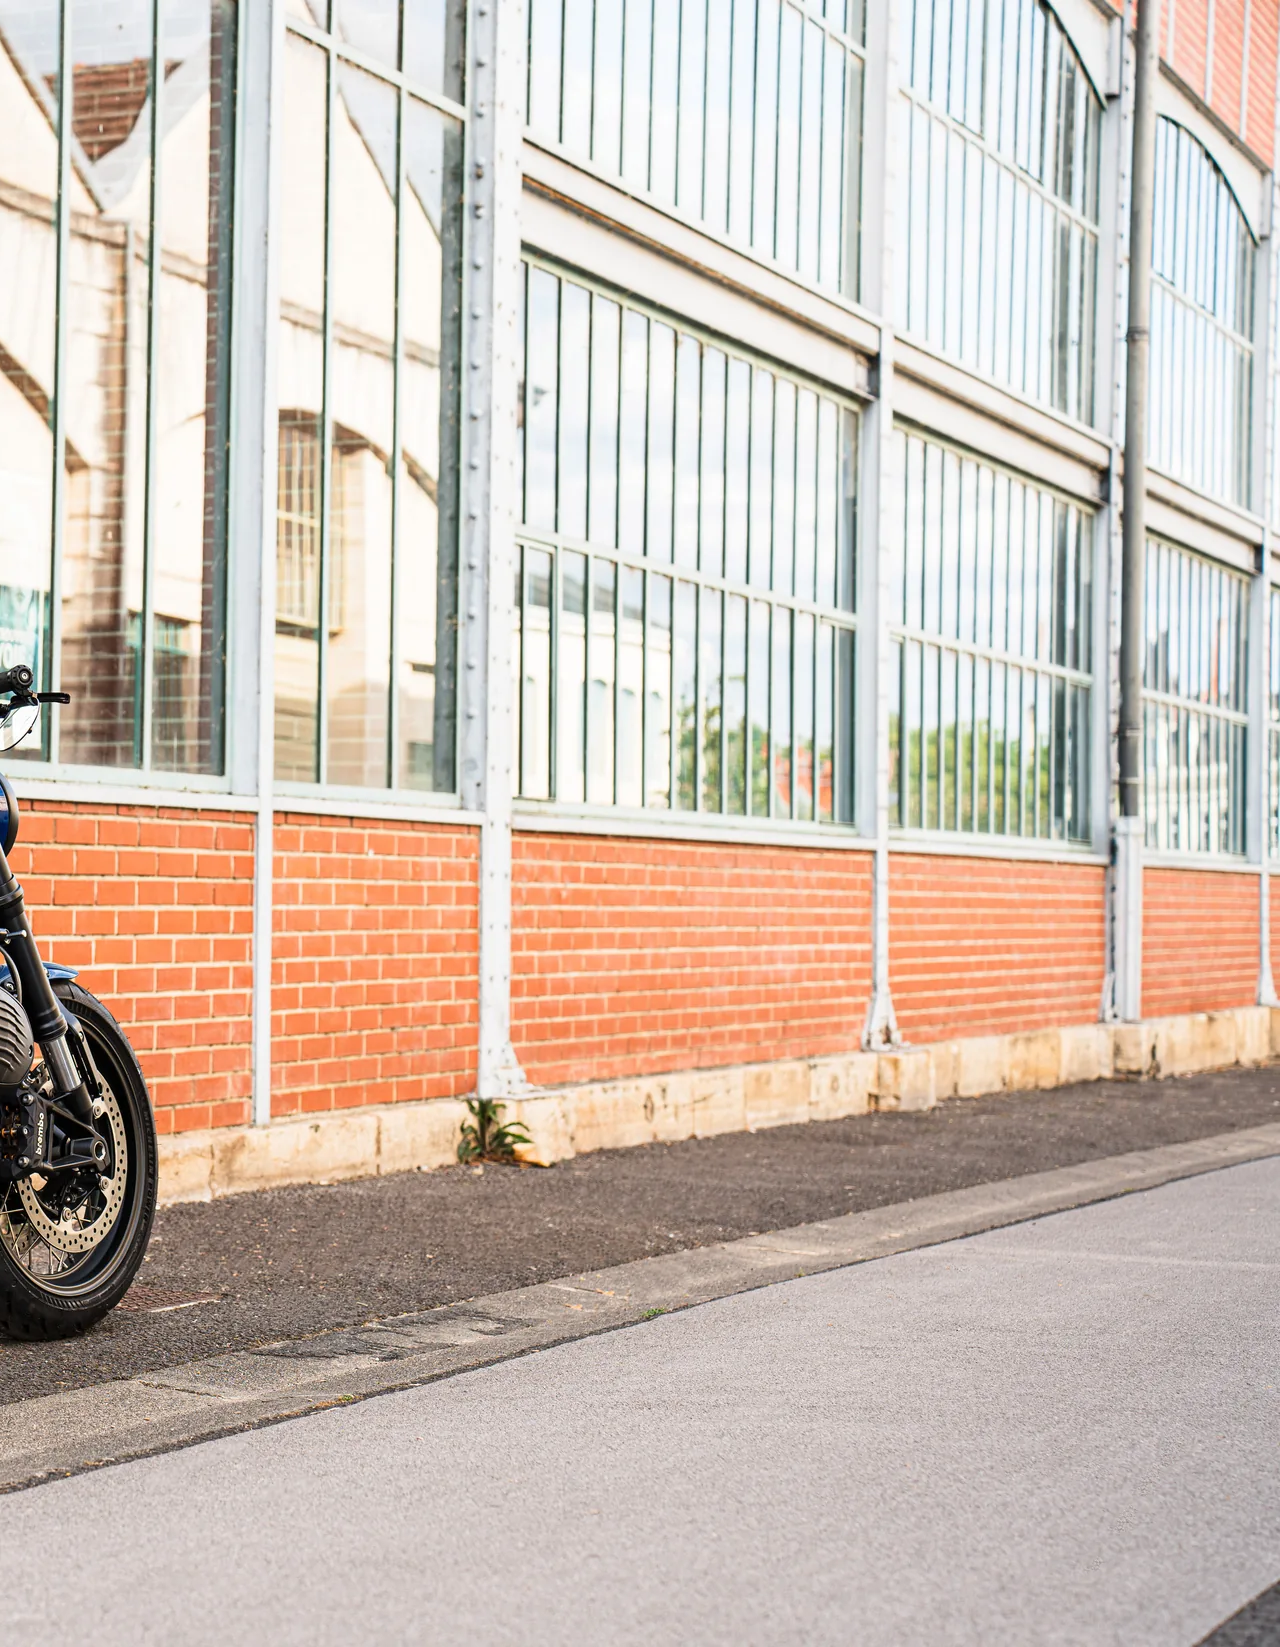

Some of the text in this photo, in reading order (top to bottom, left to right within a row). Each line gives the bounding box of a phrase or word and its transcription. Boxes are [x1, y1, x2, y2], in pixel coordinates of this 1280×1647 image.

[35, 1112, 45, 1155] brembo
[142, 1111, 154, 1222] MICHELIN POWER
